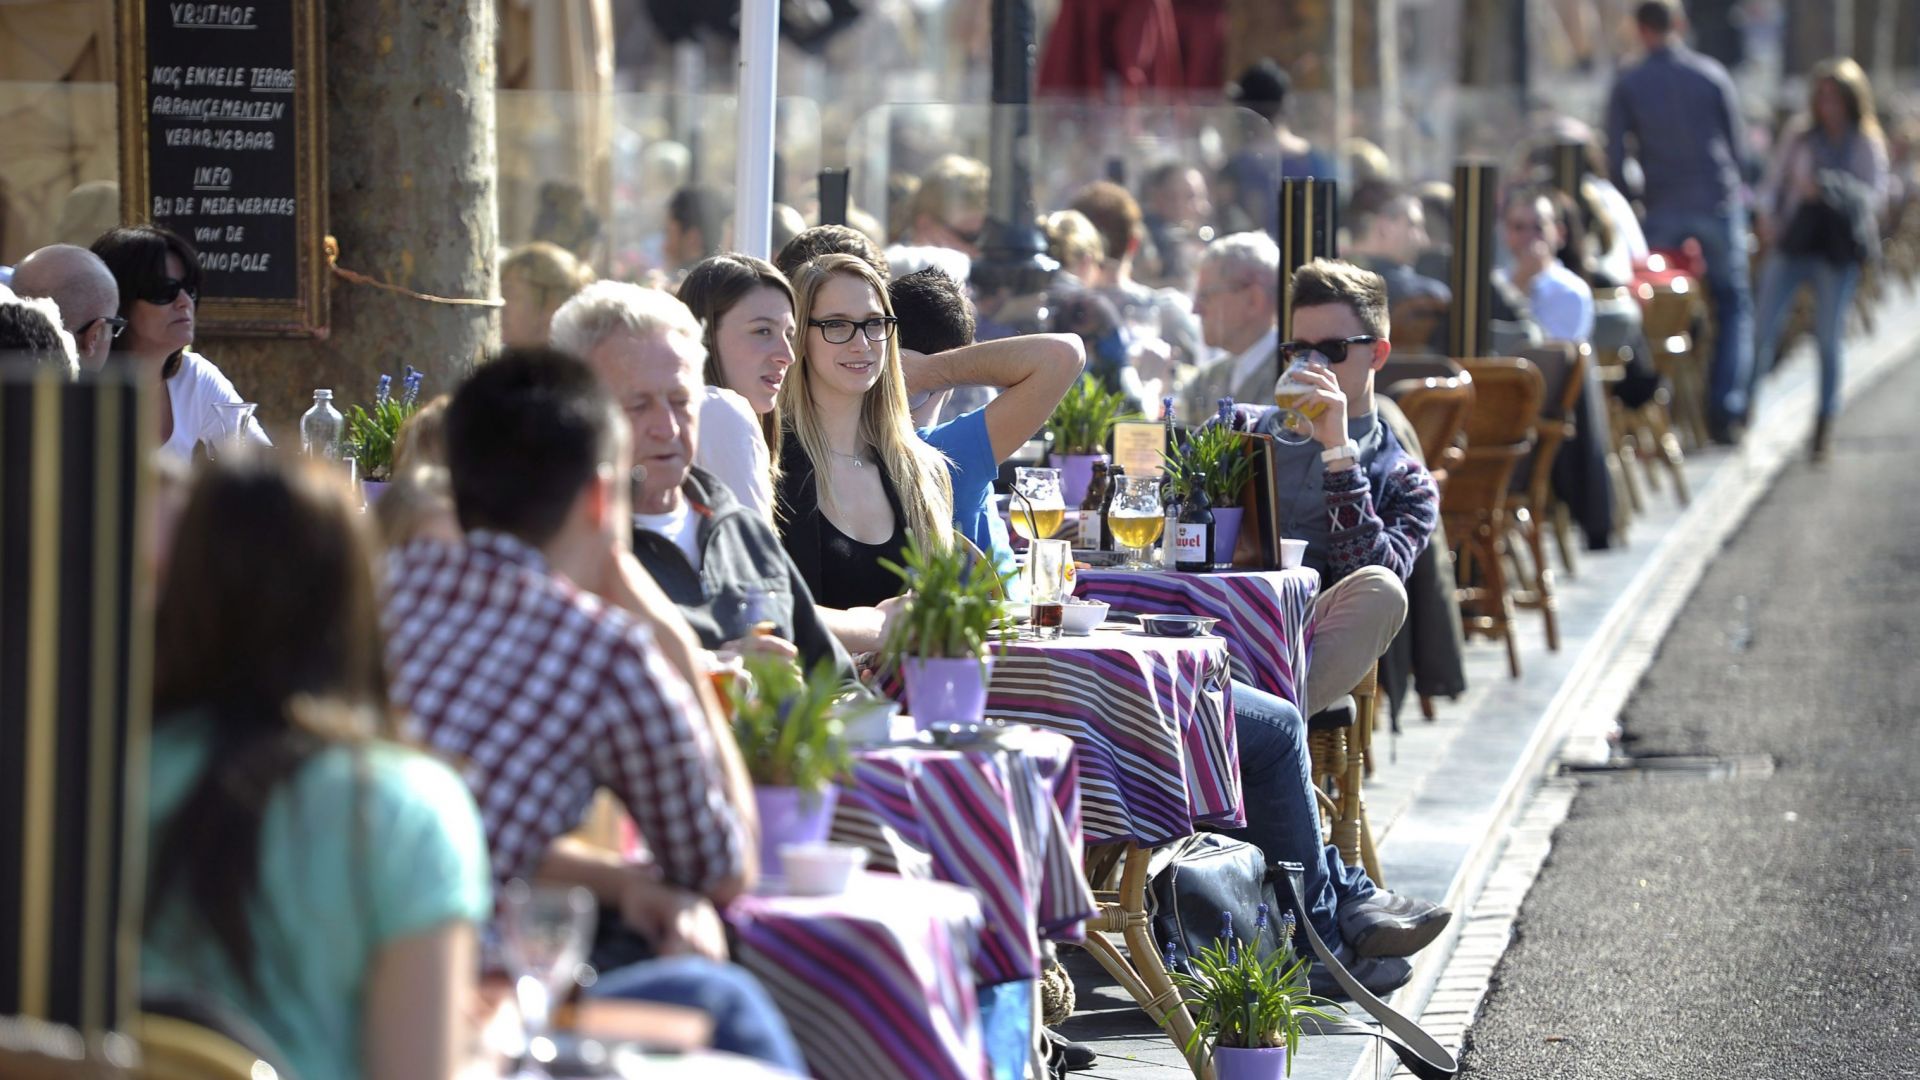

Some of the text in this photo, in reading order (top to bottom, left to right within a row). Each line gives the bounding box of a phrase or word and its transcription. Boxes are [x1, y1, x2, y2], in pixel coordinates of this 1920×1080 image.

[184, 66, 245, 87] ENKELE
[250, 67, 296, 88] TERRAS
[152, 95, 286, 122] ARRANGEMENTEN
[165, 128, 275, 151] VERKRIJGBAAR
[193, 166, 232, 186] INFO
[175, 197, 195, 215] DE
[201, 197, 296, 216] MEDEWERKERS
[194, 225, 245, 242] VAN DE
[197, 252, 271, 273] ONOPOLE
[1176, 534, 1200, 548] uvel
